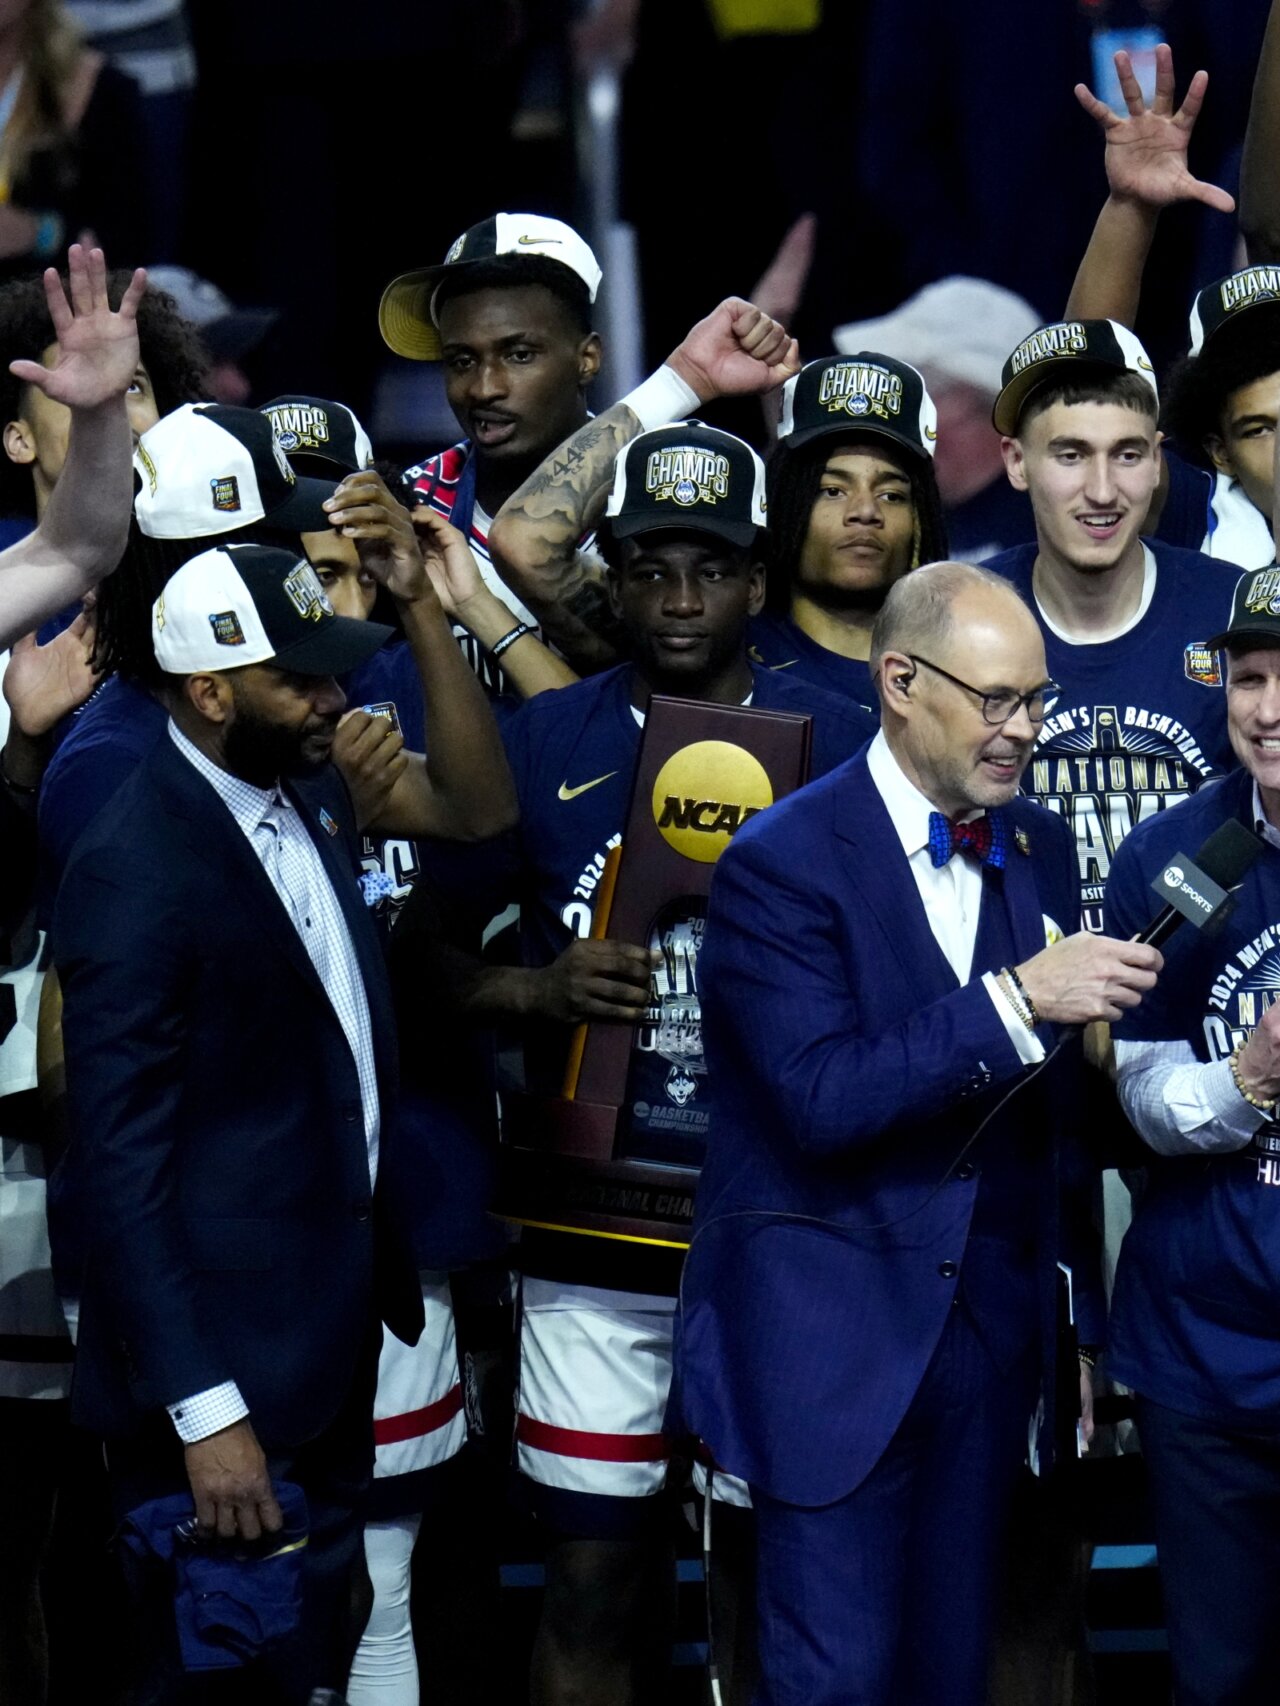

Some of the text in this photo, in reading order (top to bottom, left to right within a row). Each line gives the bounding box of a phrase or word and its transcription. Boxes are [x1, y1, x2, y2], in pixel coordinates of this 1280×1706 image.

[1011, 322, 1087, 375] CHAMPS
[819, 366, 902, 414] CHAMPS
[265, 406, 329, 441] AMPS
[215, 482, 233, 494] FINAL
[646, 450, 729, 498] CHAMPS
[216, 491, 234, 502] FOUR
[1190, 650, 1212, 660] FINAL
[1190, 658, 1212, 669] FOUR
[1124, 706, 1214, 777] BASKETBALL
[1032, 755, 1189, 794] NATIONAL
[573, 852, 606, 900] 2024
[1165, 867, 1213, 913] TNT SPORTS
[1208, 962, 1244, 1011] 2024
[651, 1105, 709, 1124] BASKETBA
